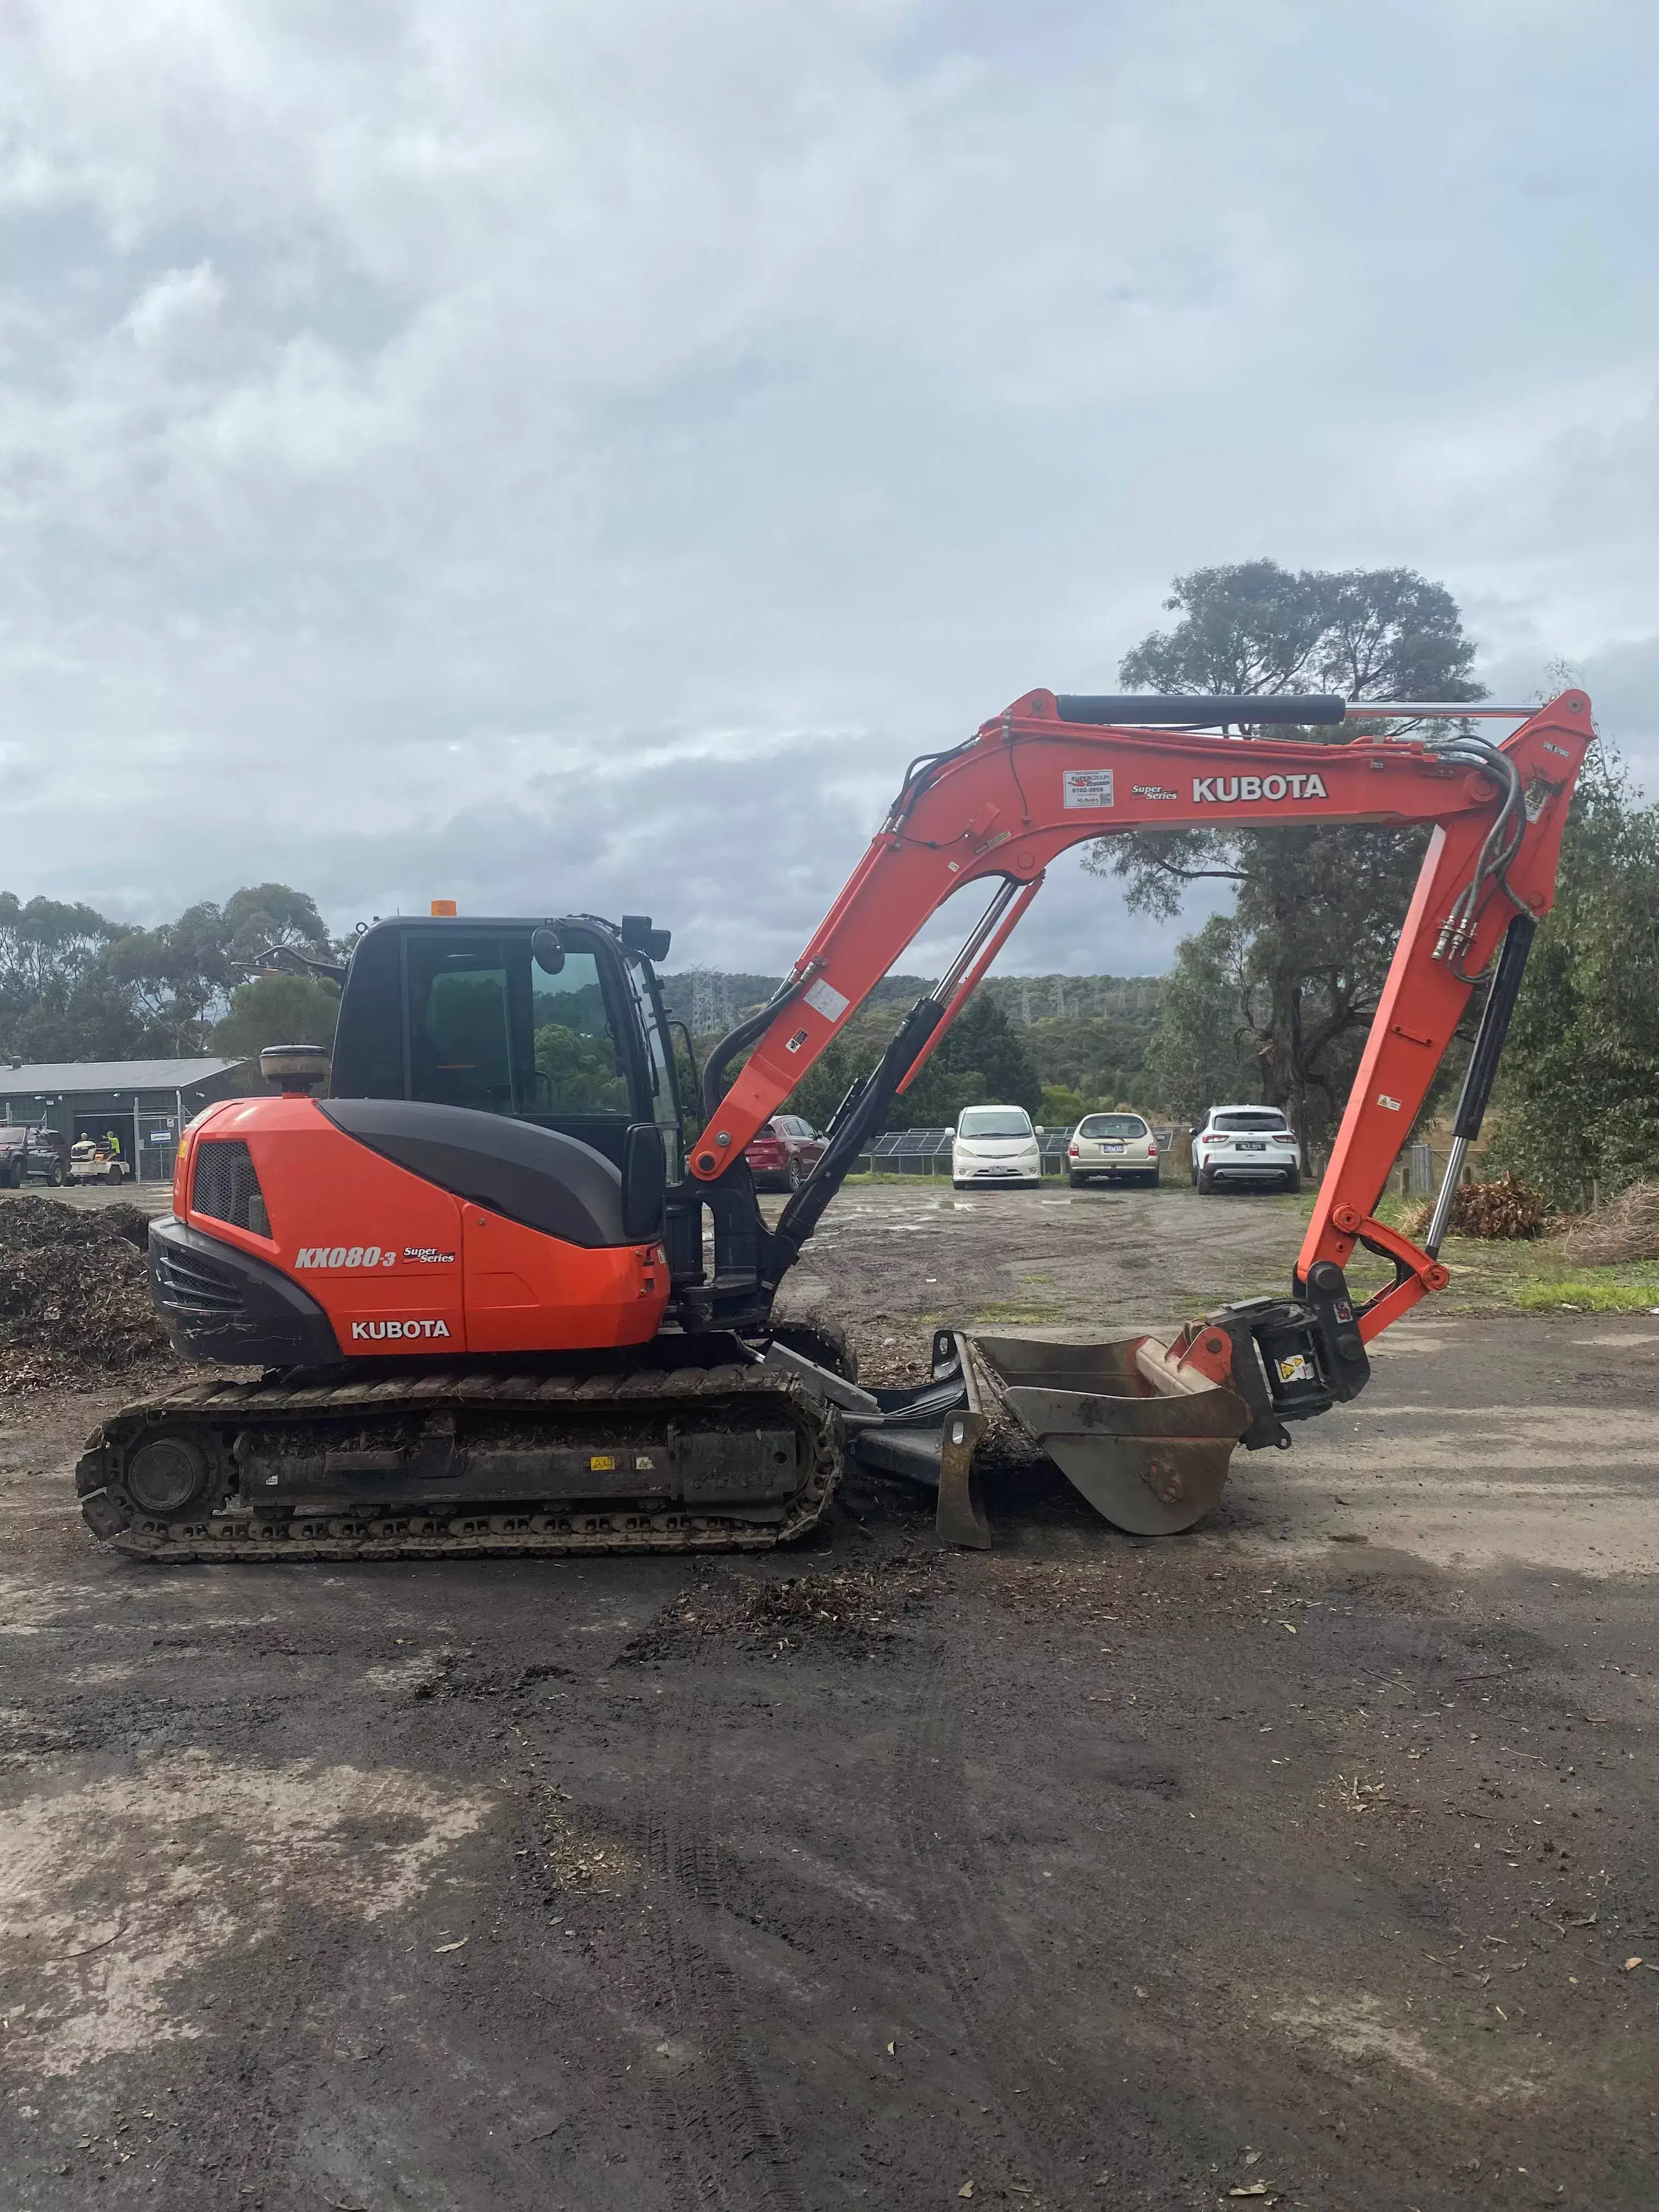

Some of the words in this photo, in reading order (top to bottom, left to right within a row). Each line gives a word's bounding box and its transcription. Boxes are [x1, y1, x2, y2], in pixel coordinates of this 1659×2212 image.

[1132, 785, 1163, 794] Super
[1192, 773, 1328, 803] KUBOTA
[1146, 792, 1177, 800] Series
[294, 1246, 397, 1268] KX080-3
[403, 1247, 438, 1257] Super
[419, 1254, 455, 1263] Series
[351, 1319, 450, 1339] KUBOTA
